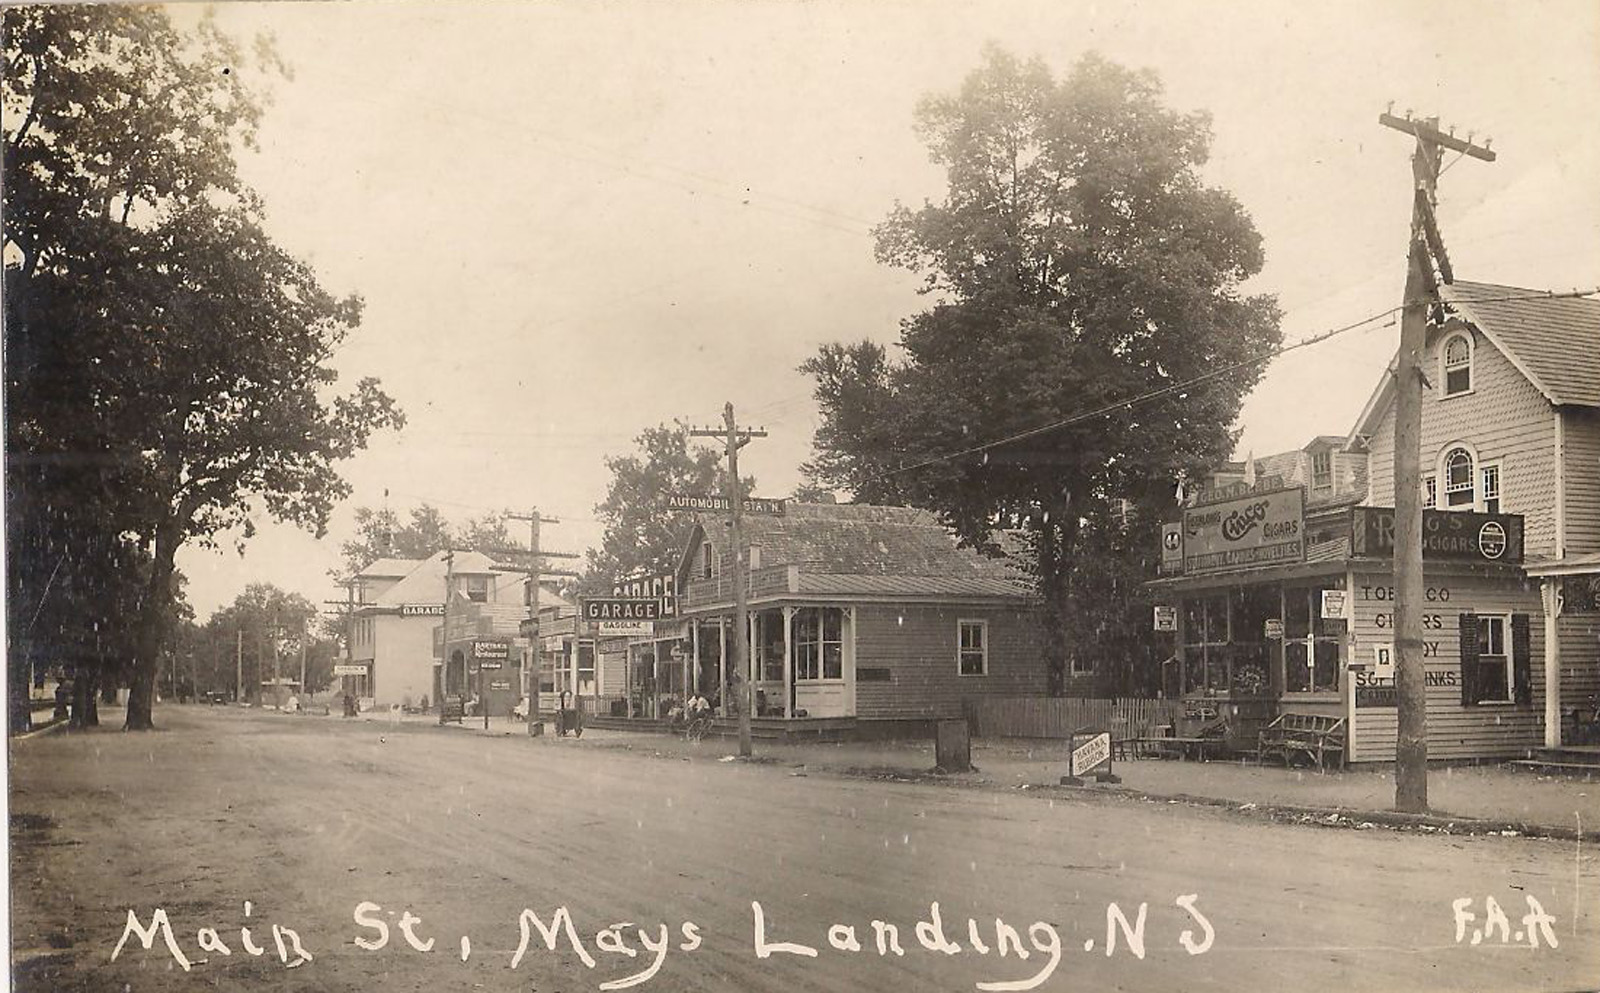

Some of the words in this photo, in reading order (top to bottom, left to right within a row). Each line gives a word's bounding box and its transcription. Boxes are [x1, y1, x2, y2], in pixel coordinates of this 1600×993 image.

[669, 496, 730, 510] AUTOMOBIL
[1263, 520, 1299, 540] CIGARS
[589, 603, 654, 618] GARAGE
[1375, 613, 1442, 629] CIRS
